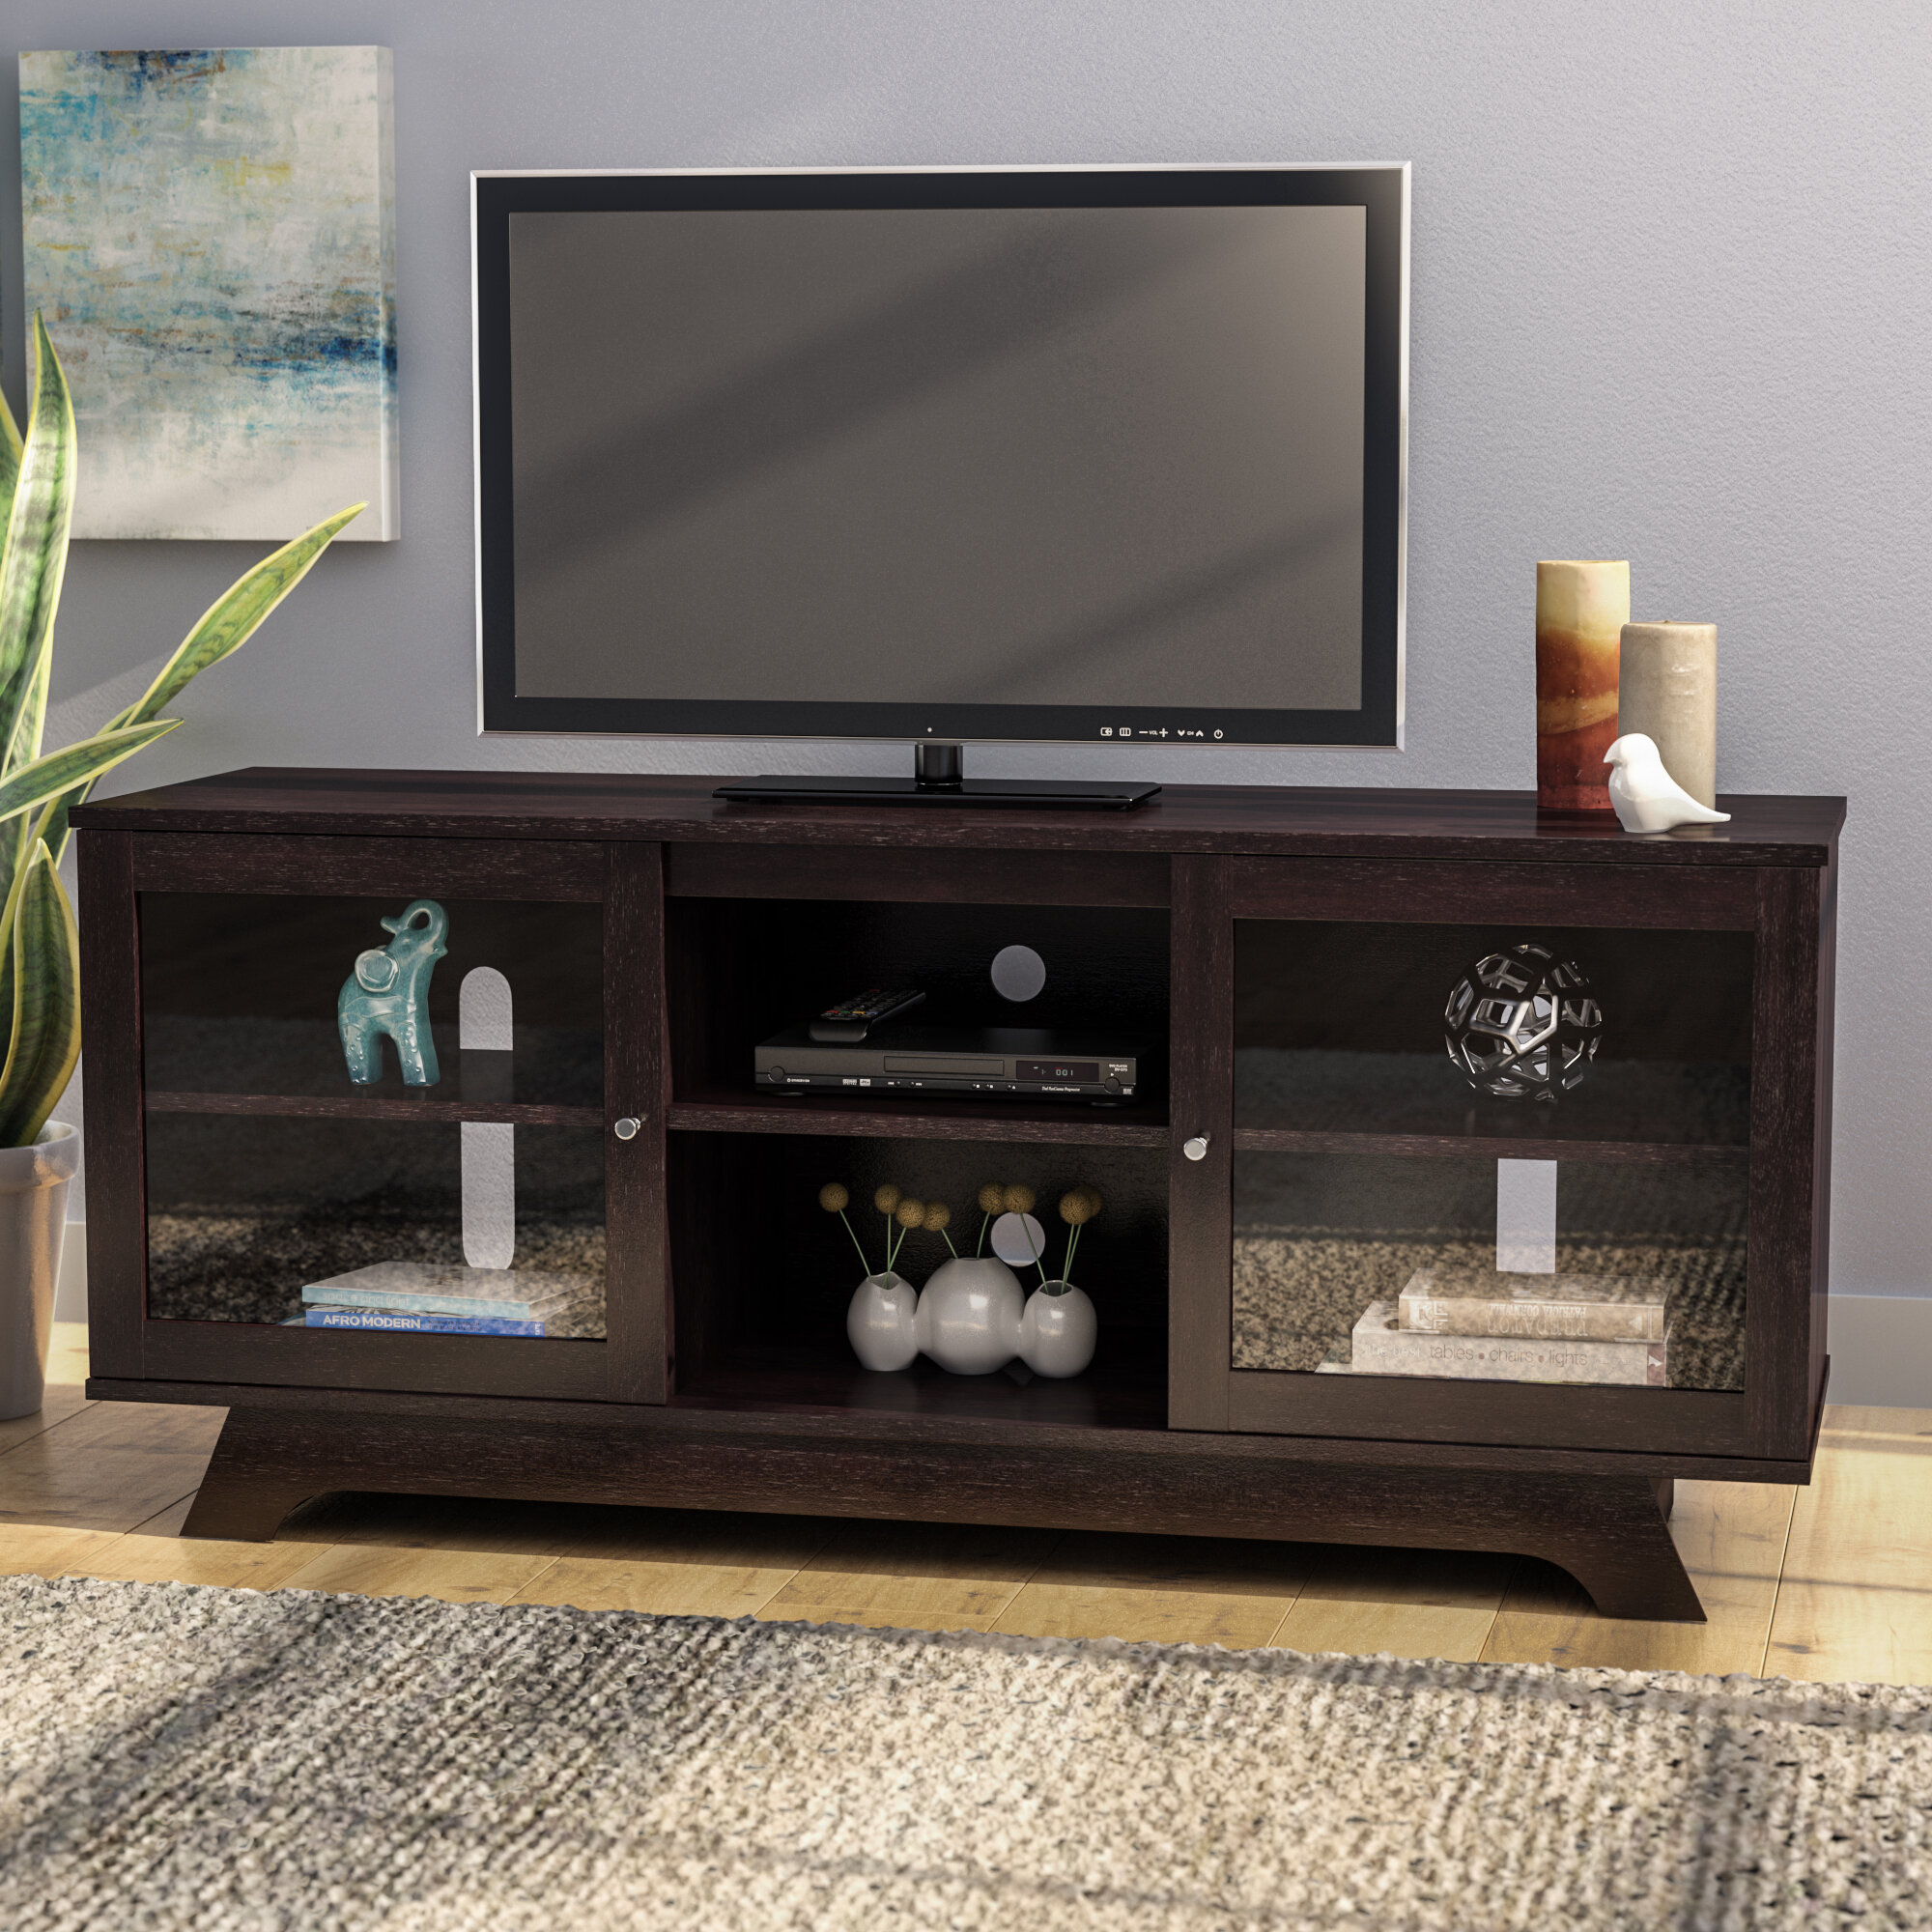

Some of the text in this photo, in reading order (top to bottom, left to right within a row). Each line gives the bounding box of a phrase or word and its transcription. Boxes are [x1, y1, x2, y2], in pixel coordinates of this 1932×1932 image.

[323, 1315, 421, 1329] AFRO MODERN
[1488, 1317, 1588, 1336] PREDATOR
[1430, 1344, 1474, 1360] tables
[1489, 1347, 1533, 1363] chairs
[1548, 1349, 1588, 1367] lights
